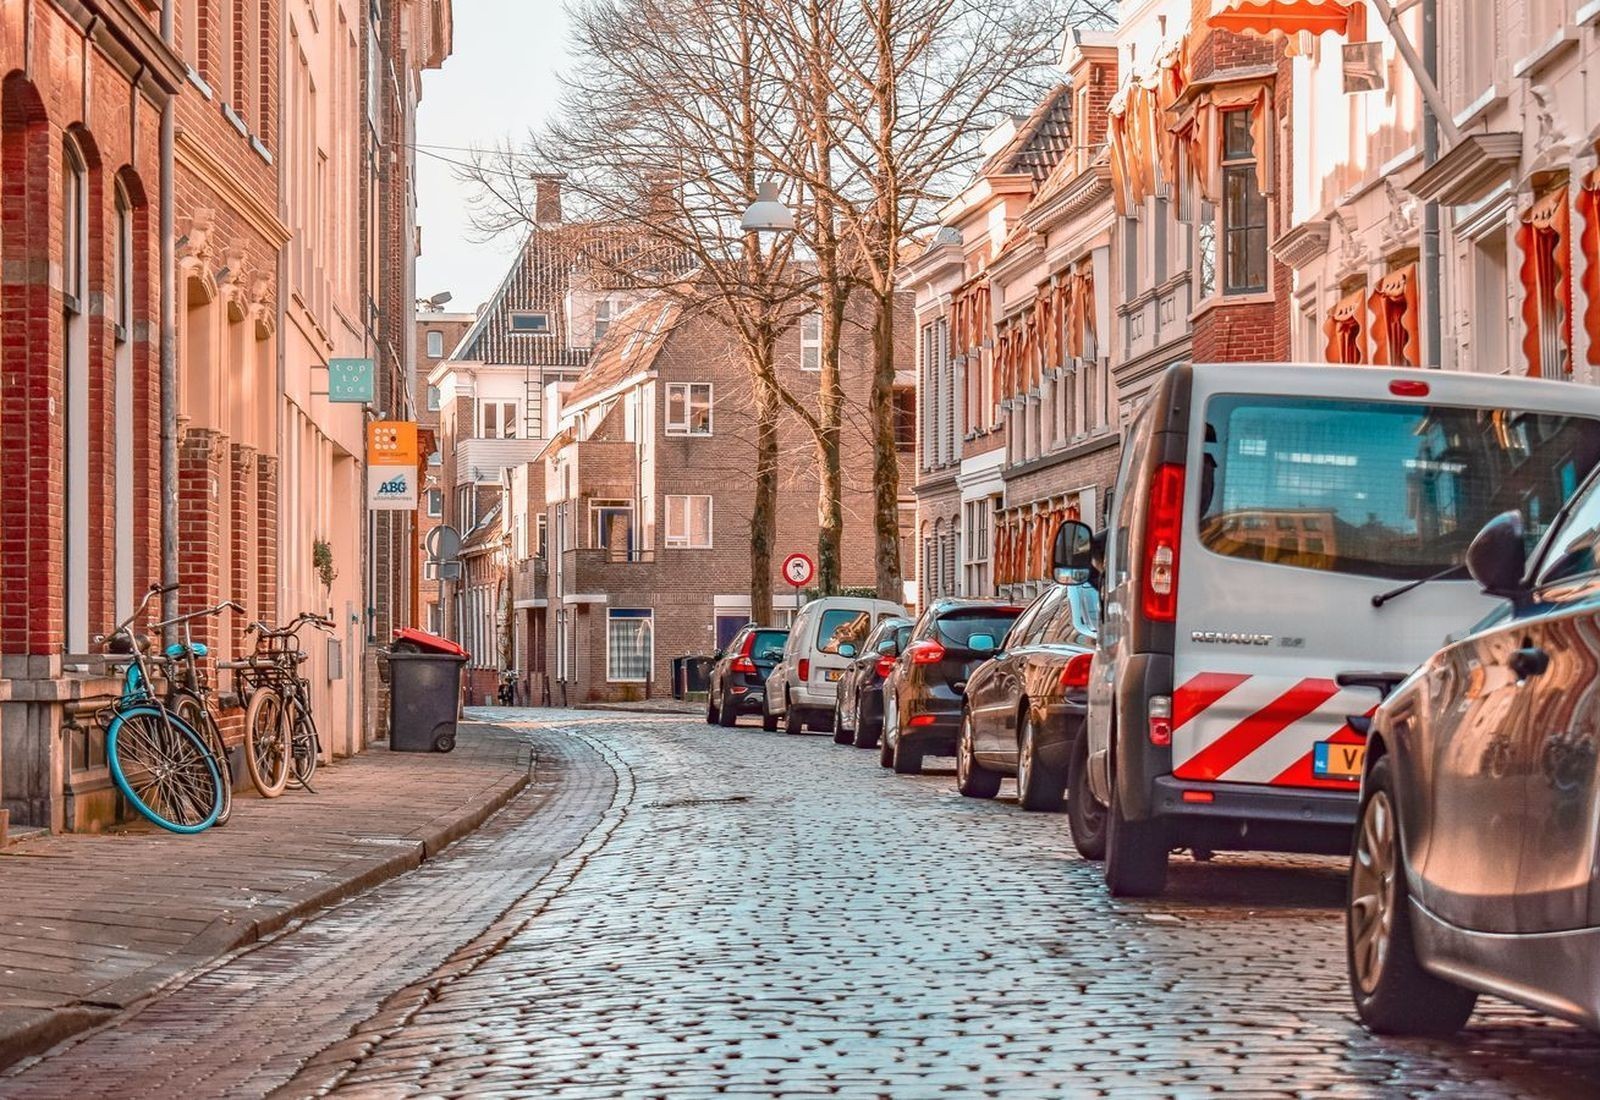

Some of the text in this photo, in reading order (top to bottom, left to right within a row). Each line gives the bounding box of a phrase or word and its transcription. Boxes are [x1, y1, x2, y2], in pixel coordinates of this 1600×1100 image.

[335, 364, 366, 374] top
[342, 374, 359, 382] to
[378, 481, 407, 493] ABG
[1191, 631, 1273, 646] RENAULT
[1315, 760, 1326, 769] NL
